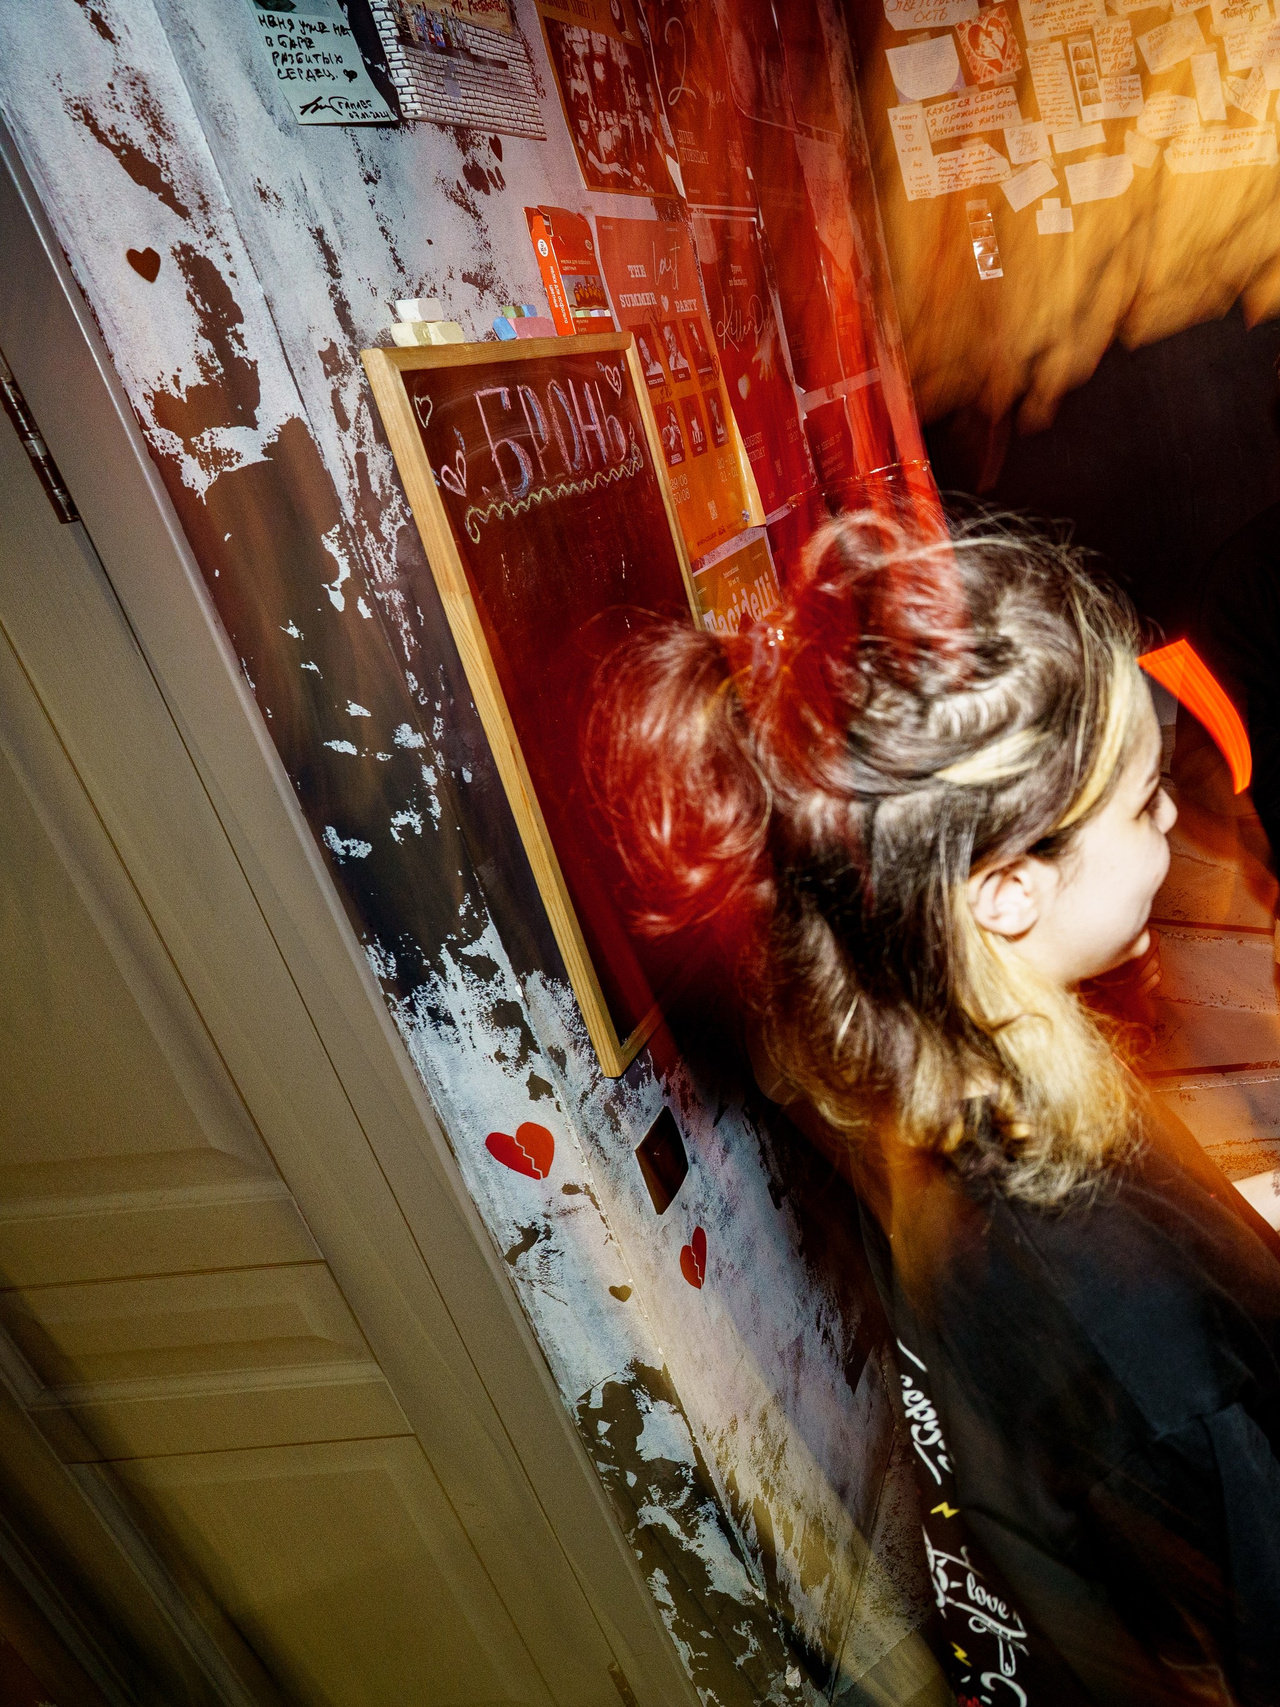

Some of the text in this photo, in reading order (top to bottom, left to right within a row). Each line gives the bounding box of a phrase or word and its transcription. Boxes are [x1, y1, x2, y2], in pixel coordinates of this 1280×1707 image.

[265, 35, 315, 50] В БАРЕ
[271, 51, 343, 67] РАЗБИТЫХ
[926, 88, 1011, 117] КАЖЕТСЯ СЕЙЧАС
[930, 119, 936, 127] Я
[942, 105, 995, 124] ПРОЖИВАЮ
[627, 264, 648, 278] THE
[618, 292, 698, 313] SUMMER PARTY
[474, 378, 630, 501] БРОНЬ
